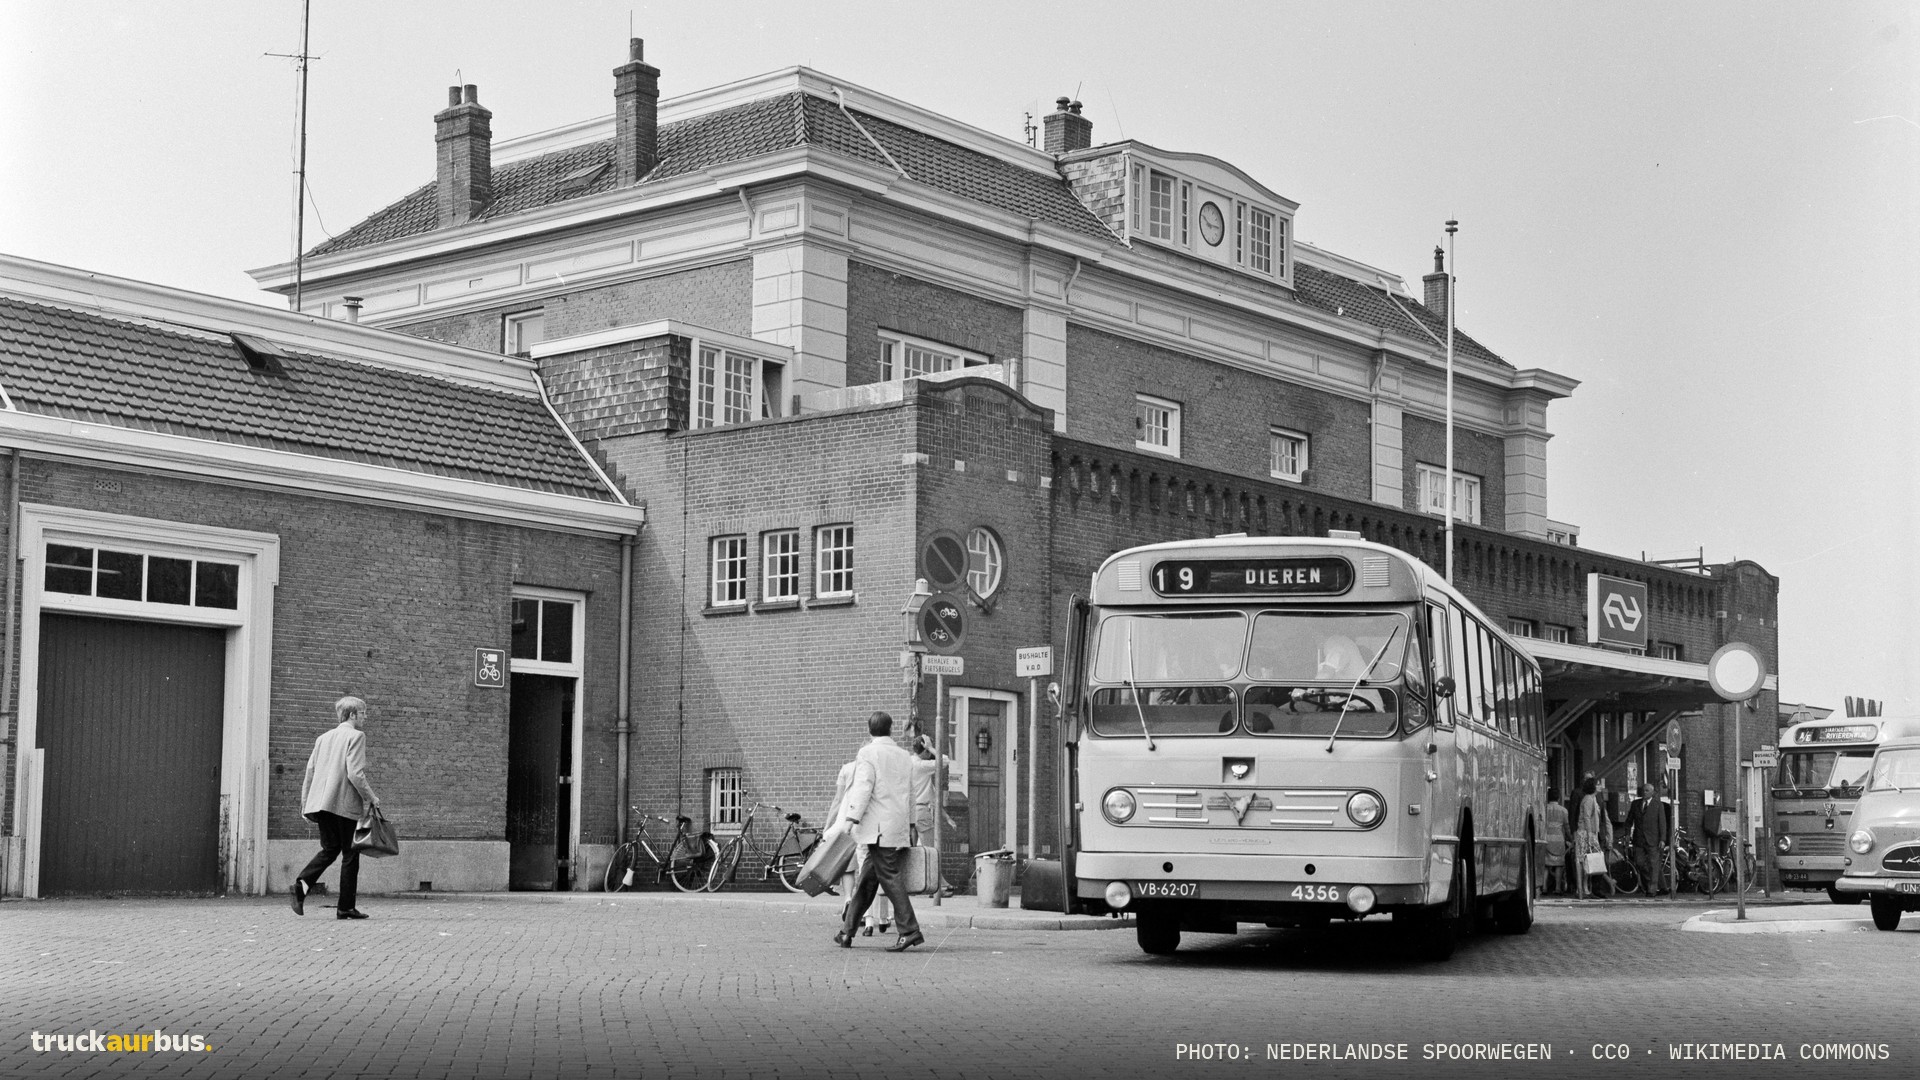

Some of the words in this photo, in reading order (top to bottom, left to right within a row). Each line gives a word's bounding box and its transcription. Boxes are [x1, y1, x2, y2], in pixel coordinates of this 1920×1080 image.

[1246, 568, 1320, 584] DIEREN
[927, 657, 950, 665] BEHALVE
[925, 665, 961, 673] FIETSBEUGELS
[1291, 885, 1340, 900] 4356
